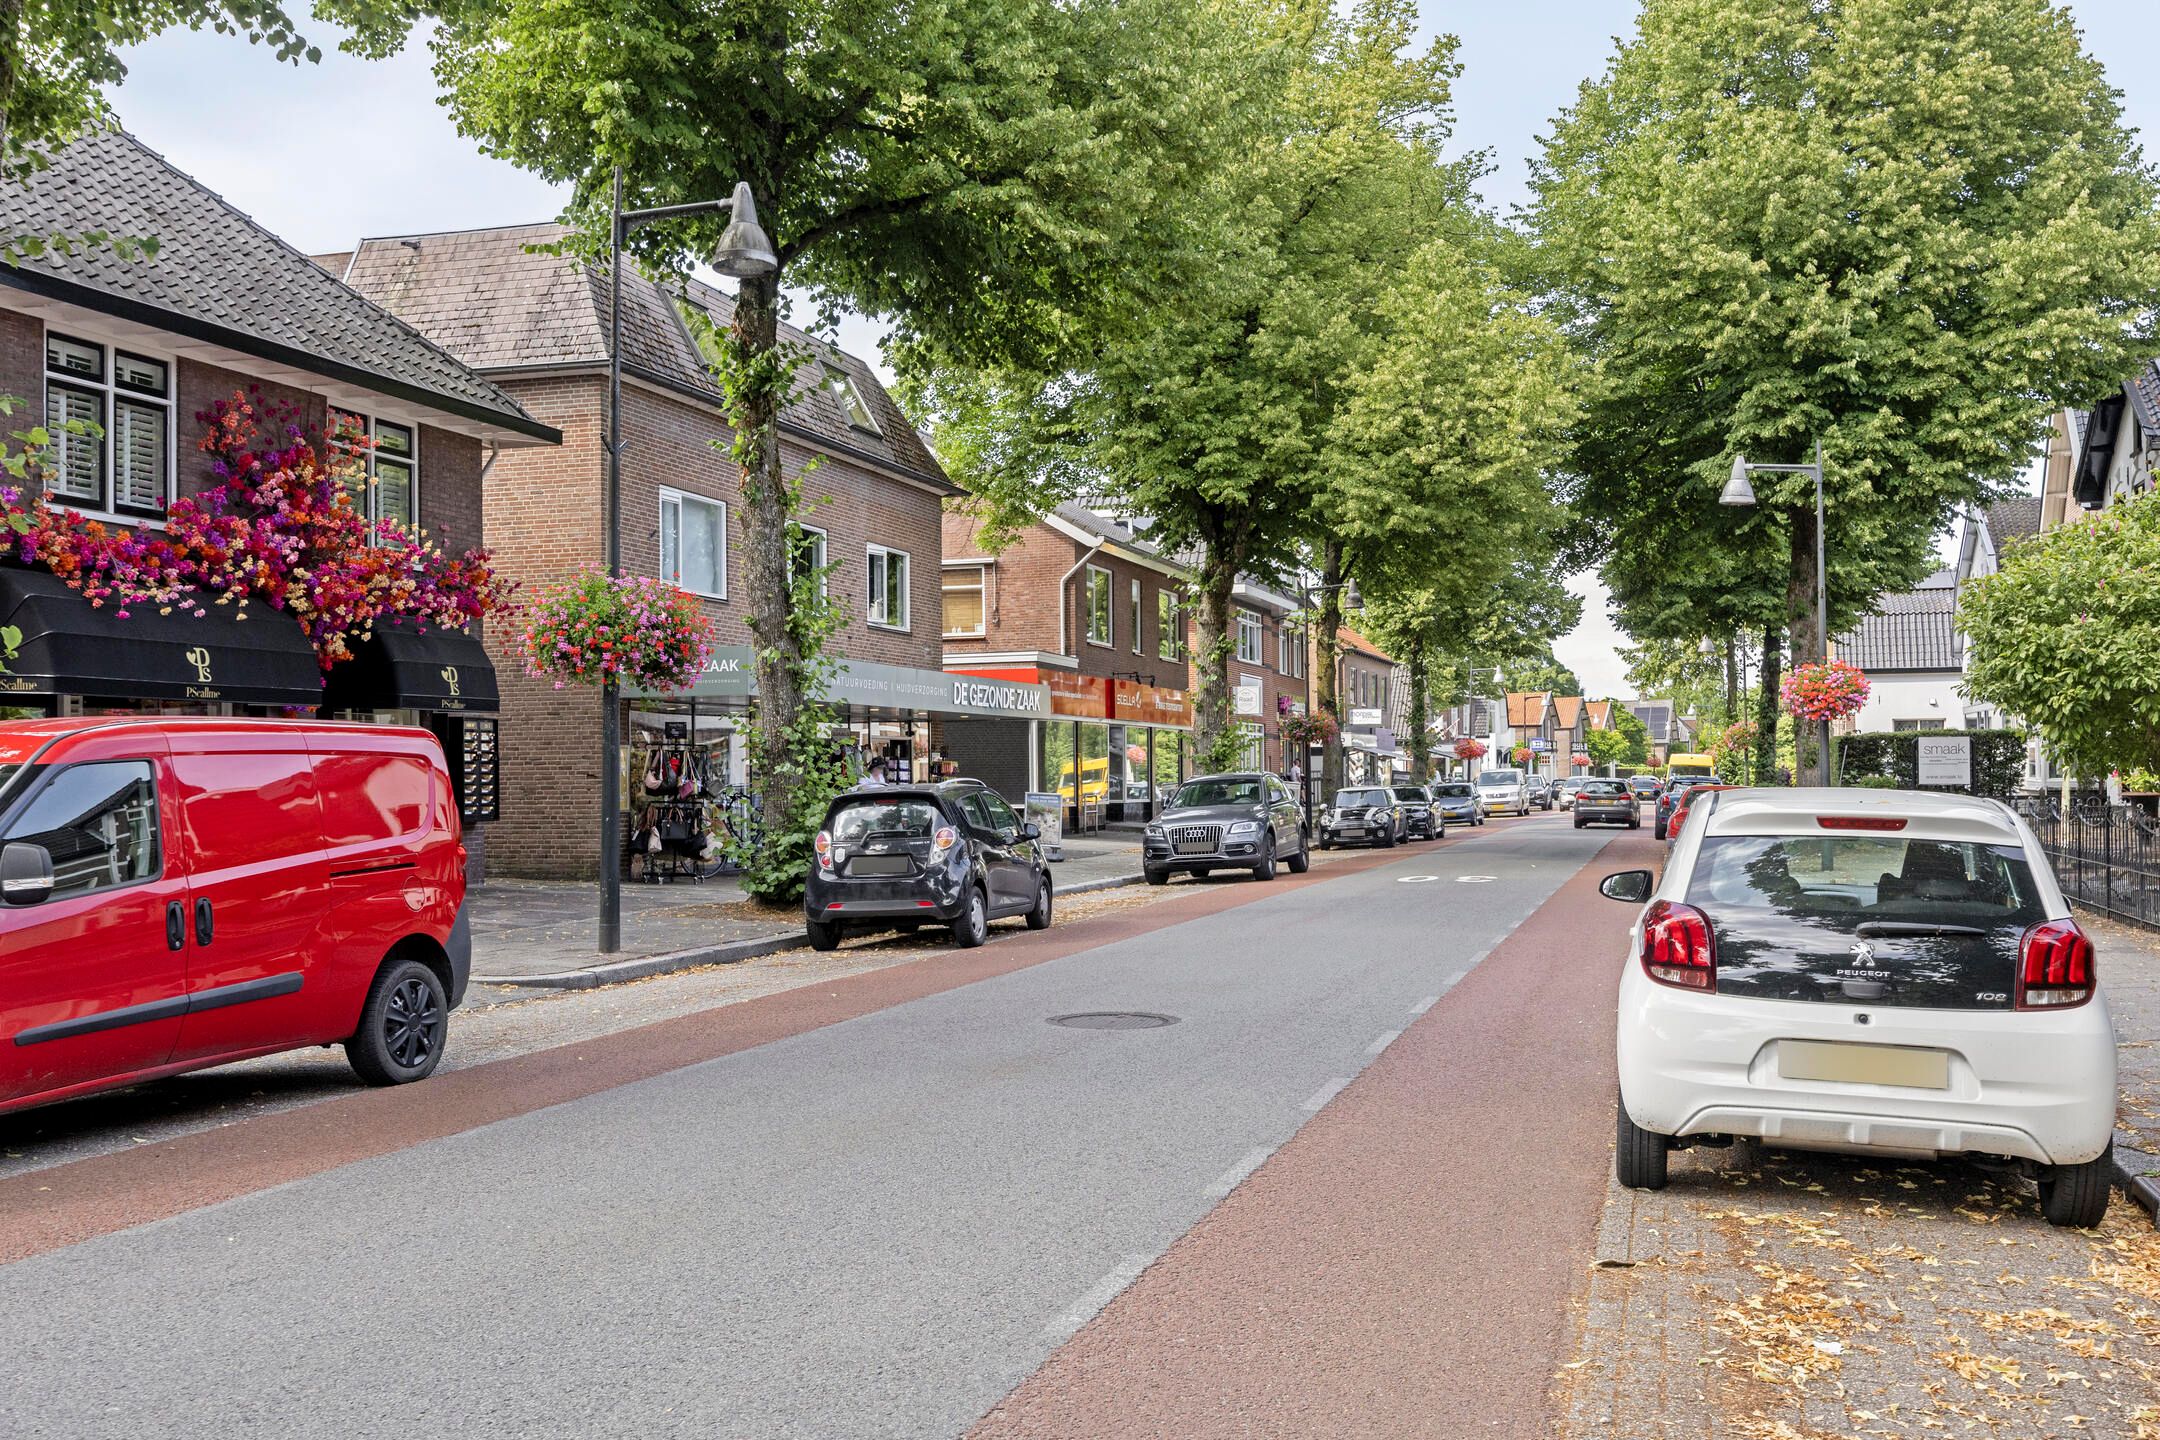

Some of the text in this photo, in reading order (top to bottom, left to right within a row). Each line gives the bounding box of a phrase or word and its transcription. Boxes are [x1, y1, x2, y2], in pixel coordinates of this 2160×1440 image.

[701, 658, 739, 672] ZAAK
[0, 677, 38, 691] Scallme
[896, 683, 948, 697] HUIDVERZORGING
[953, 681, 968, 705] DE
[969, 683, 1015, 710] GEZONDE
[1016, 689, 1040, 712] ZAAK
[1923, 744, 1966, 755] smaak
[1836, 969, 1891, 978] PEUGEOT
[1976, 992, 2007, 1002] 108
